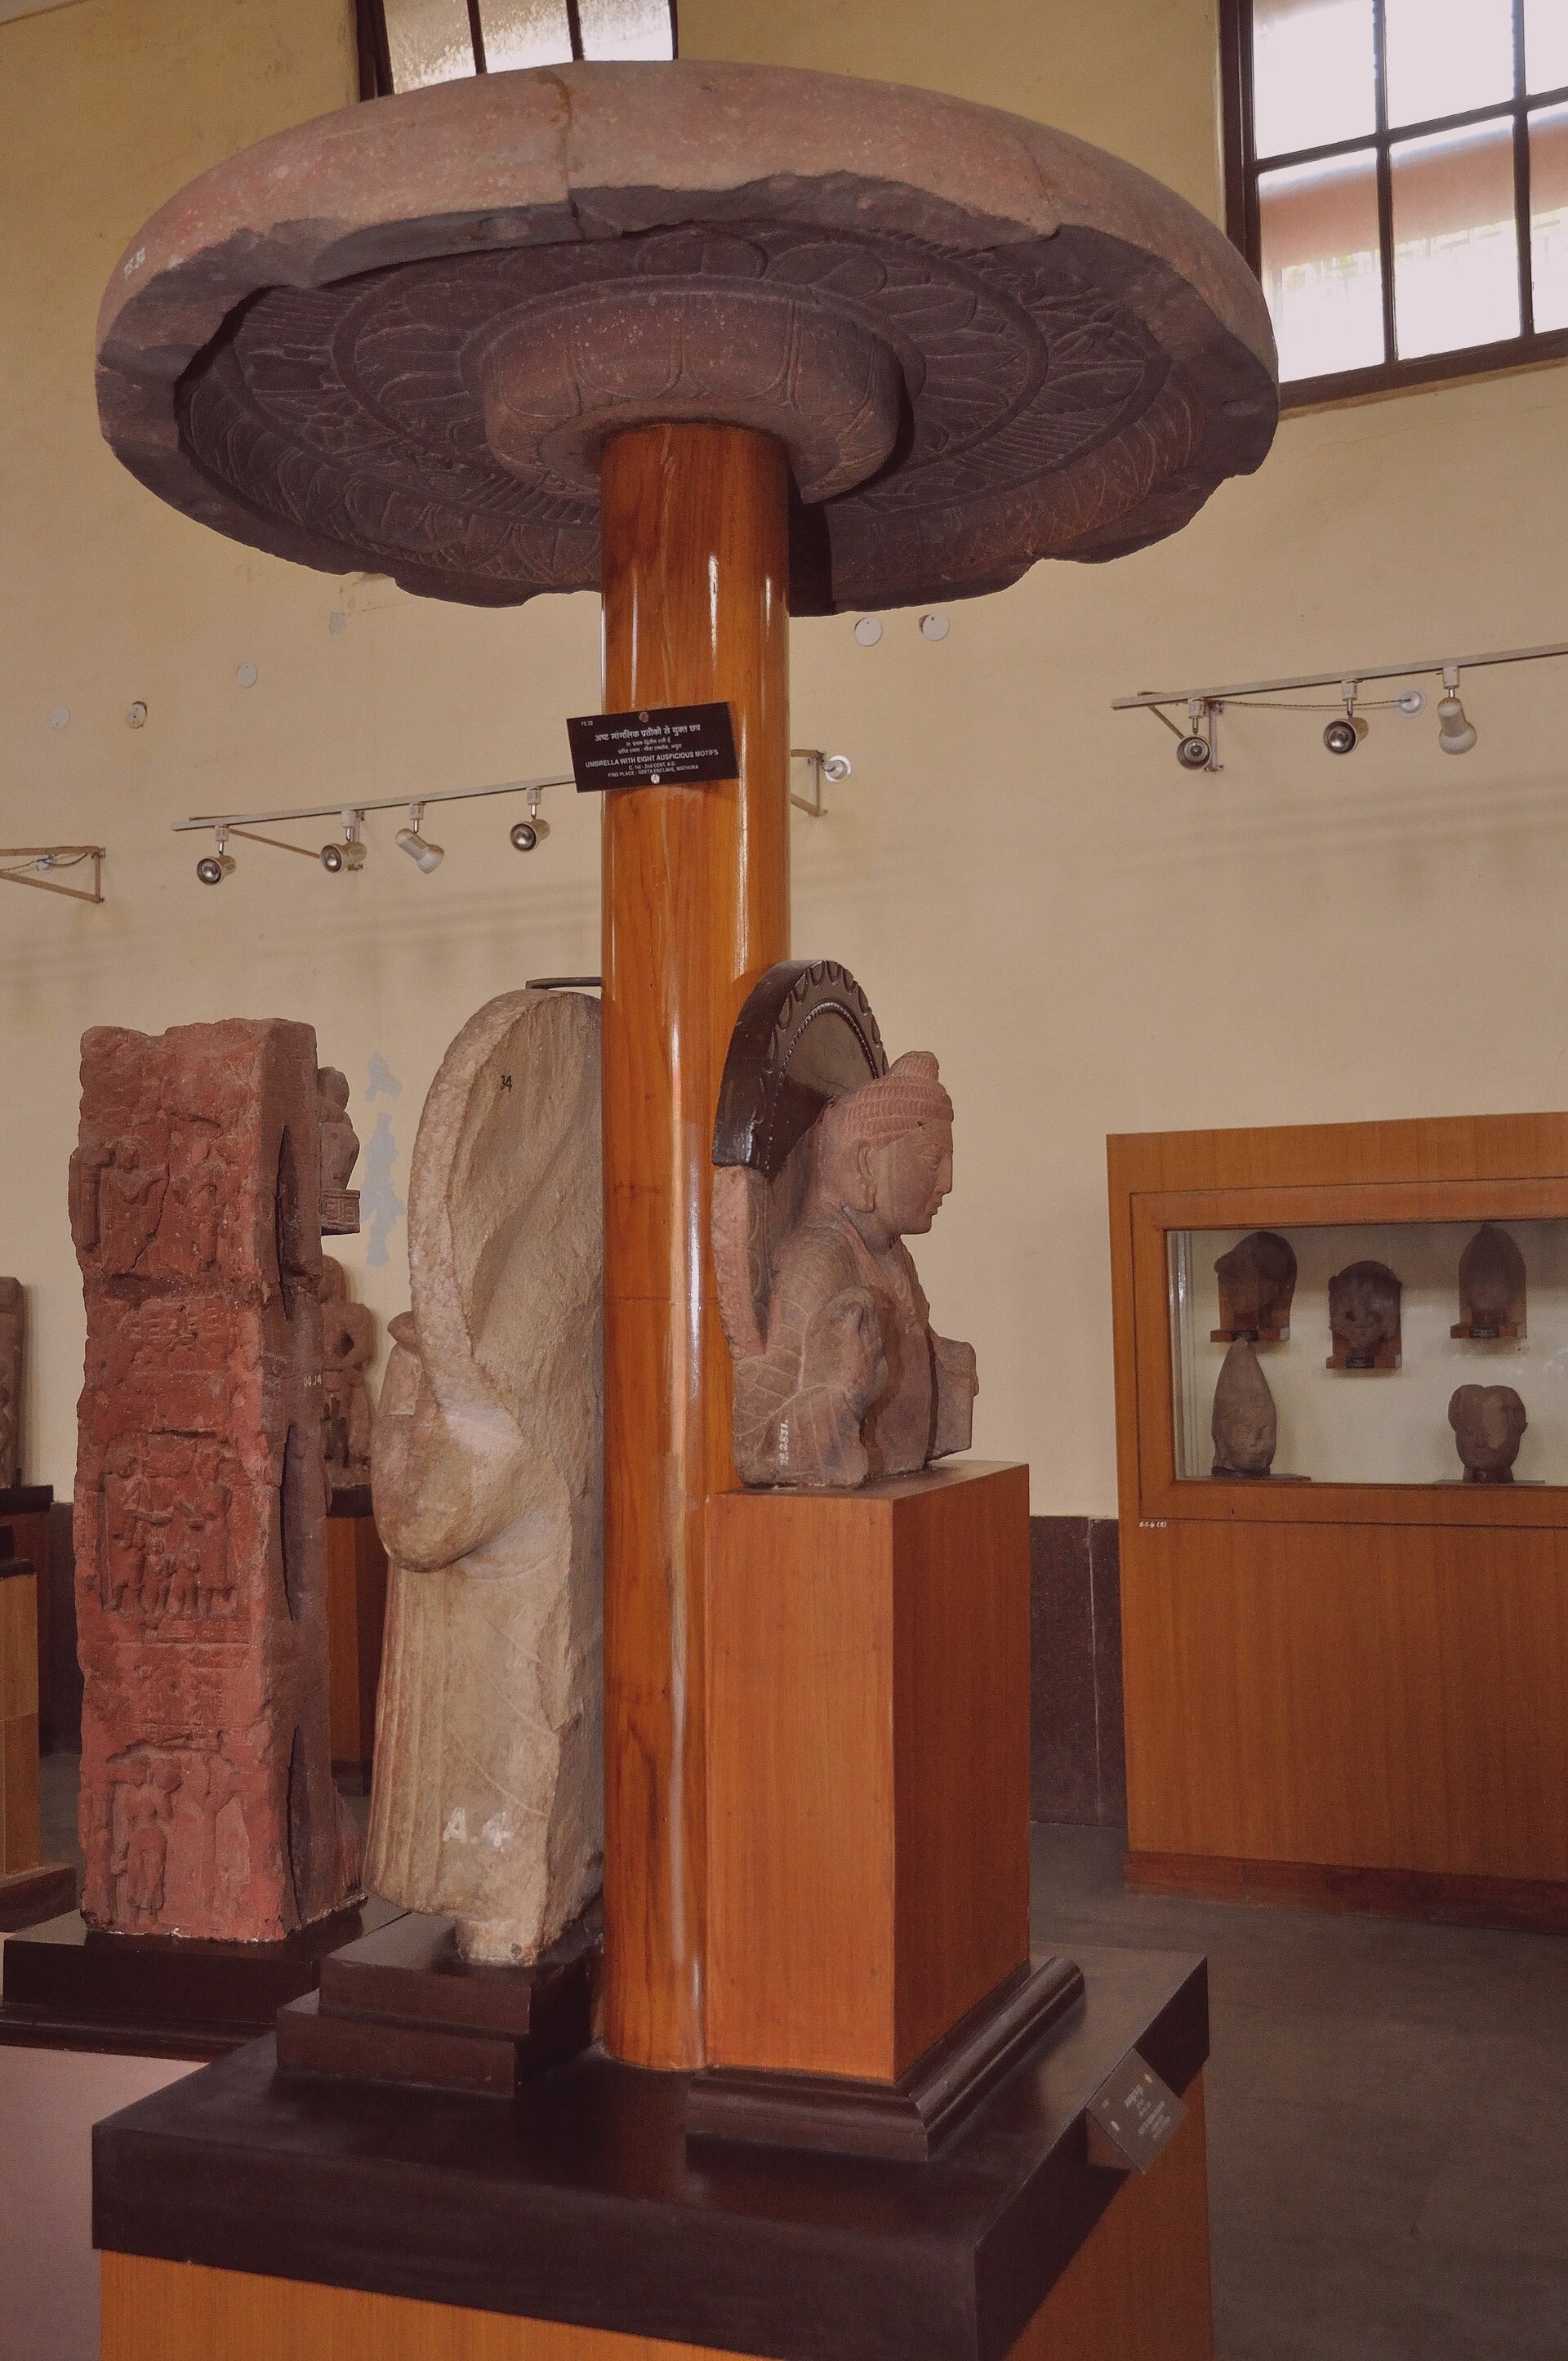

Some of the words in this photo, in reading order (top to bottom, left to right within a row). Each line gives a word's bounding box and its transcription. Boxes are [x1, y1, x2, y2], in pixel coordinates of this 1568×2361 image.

[663, 725, 670, 735] से
[585, 758, 620, 768] UMBRELLA
[620, 756, 636, 764] WITH
[637, 755, 655, 764] EIGHT
[656, 751, 694, 762] AUSPICIOUS
[694, 749, 719, 758] MOTIFS
